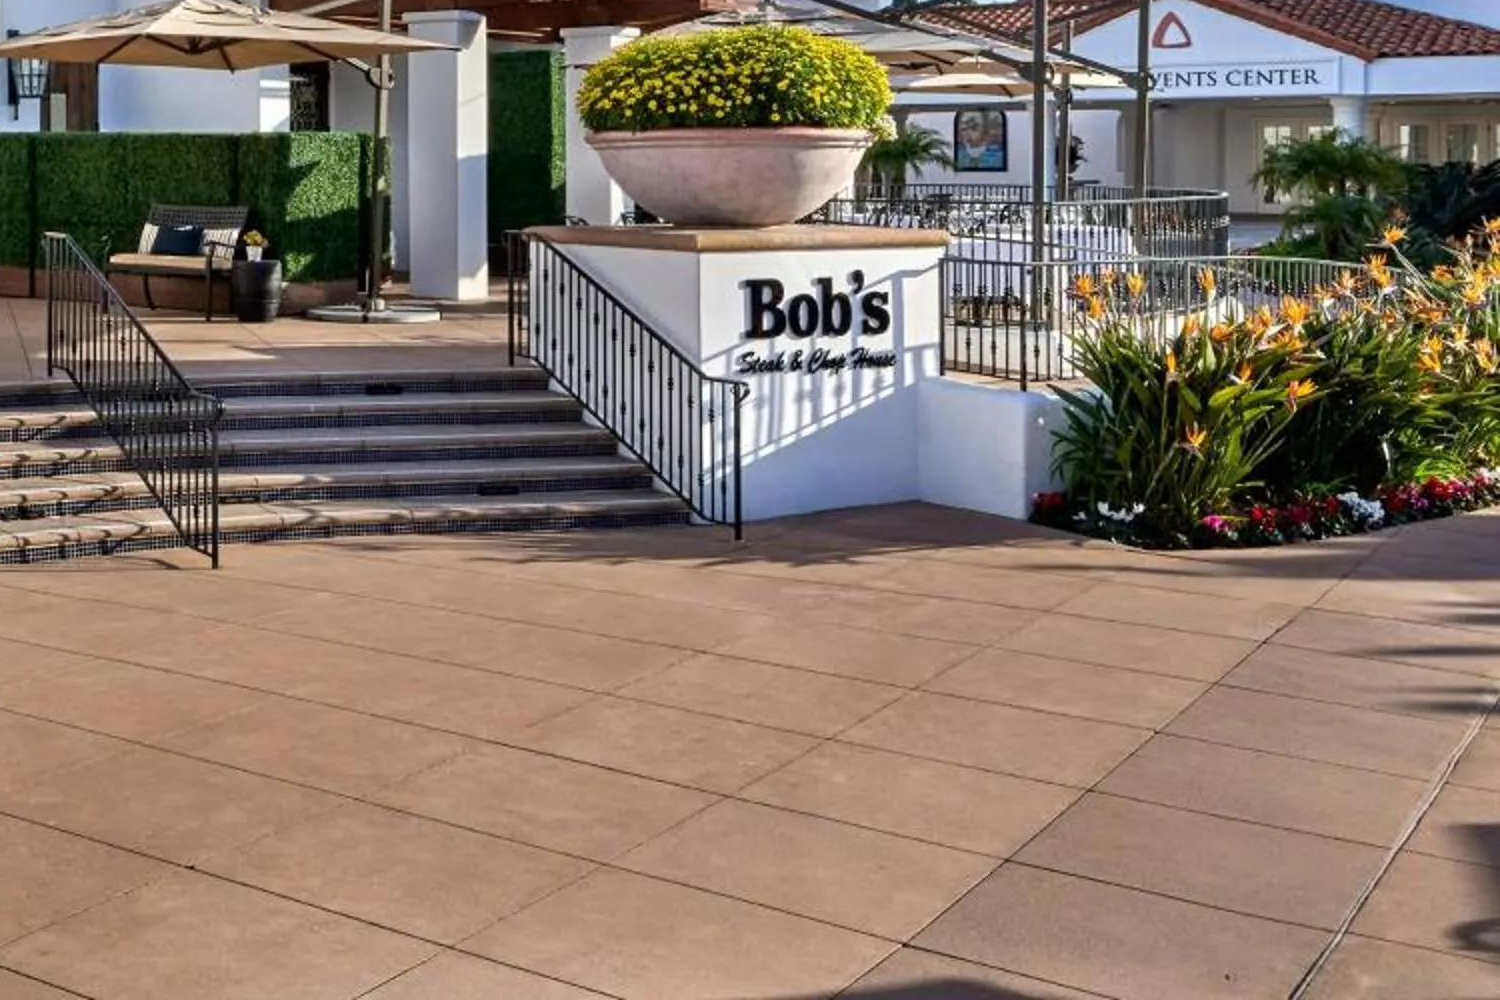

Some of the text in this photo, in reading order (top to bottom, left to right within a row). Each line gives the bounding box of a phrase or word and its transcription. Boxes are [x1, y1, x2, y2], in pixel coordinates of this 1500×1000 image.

[1138, 68, 1321, 88] VENTS CENTER
[741, 269, 891, 339] Bob's
[737, 347, 897, 375] Steak & Chop House
